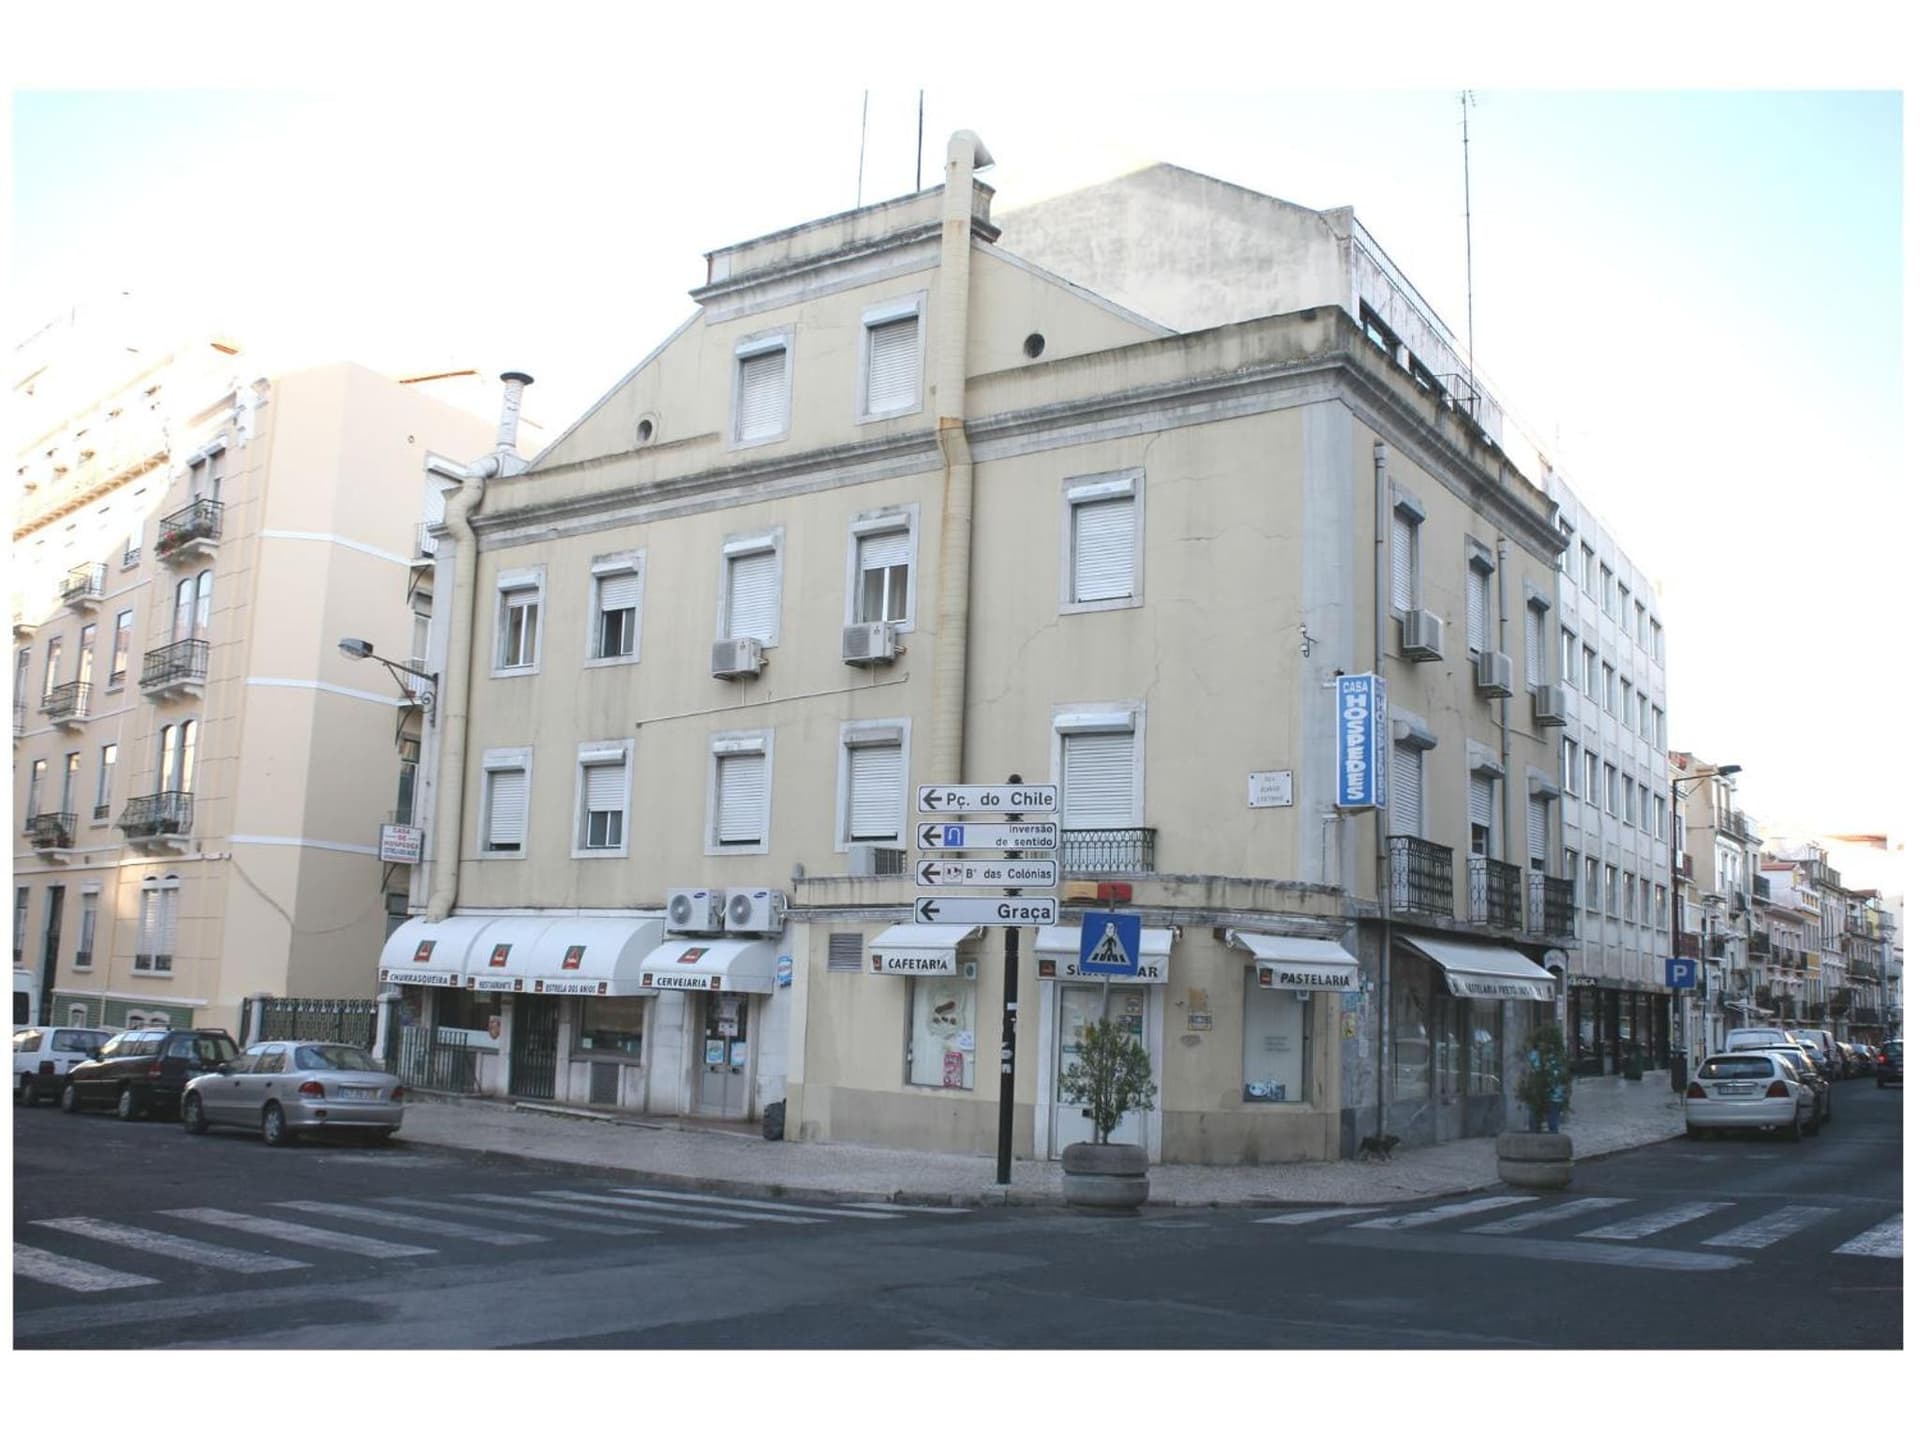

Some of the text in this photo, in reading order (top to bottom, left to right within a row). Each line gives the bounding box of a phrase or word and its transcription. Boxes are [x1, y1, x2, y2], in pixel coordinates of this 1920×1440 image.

[1343, 681, 1368, 693] CASA
[1343, 694, 1368, 800] HOSPEDES
[980, 792, 1000, 806] do
[1010, 792, 1053, 806] Chile
[1009, 824, 1053, 834] Inversão
[995, 837, 1053, 846] de sentido
[983, 868, 1001, 879] das
[997, 903, 1050, 923] Graça
[888, 958, 948, 970] CAFETARIA
[389, 973, 448, 985] CHURRASQUEIRA
[1280, 972, 1350, 987] PASTELARIA
[1673, 965, 1688, 982] P
[567, 984, 579, 993] DOS
[656, 977, 707, 988] CERVEJARIA
